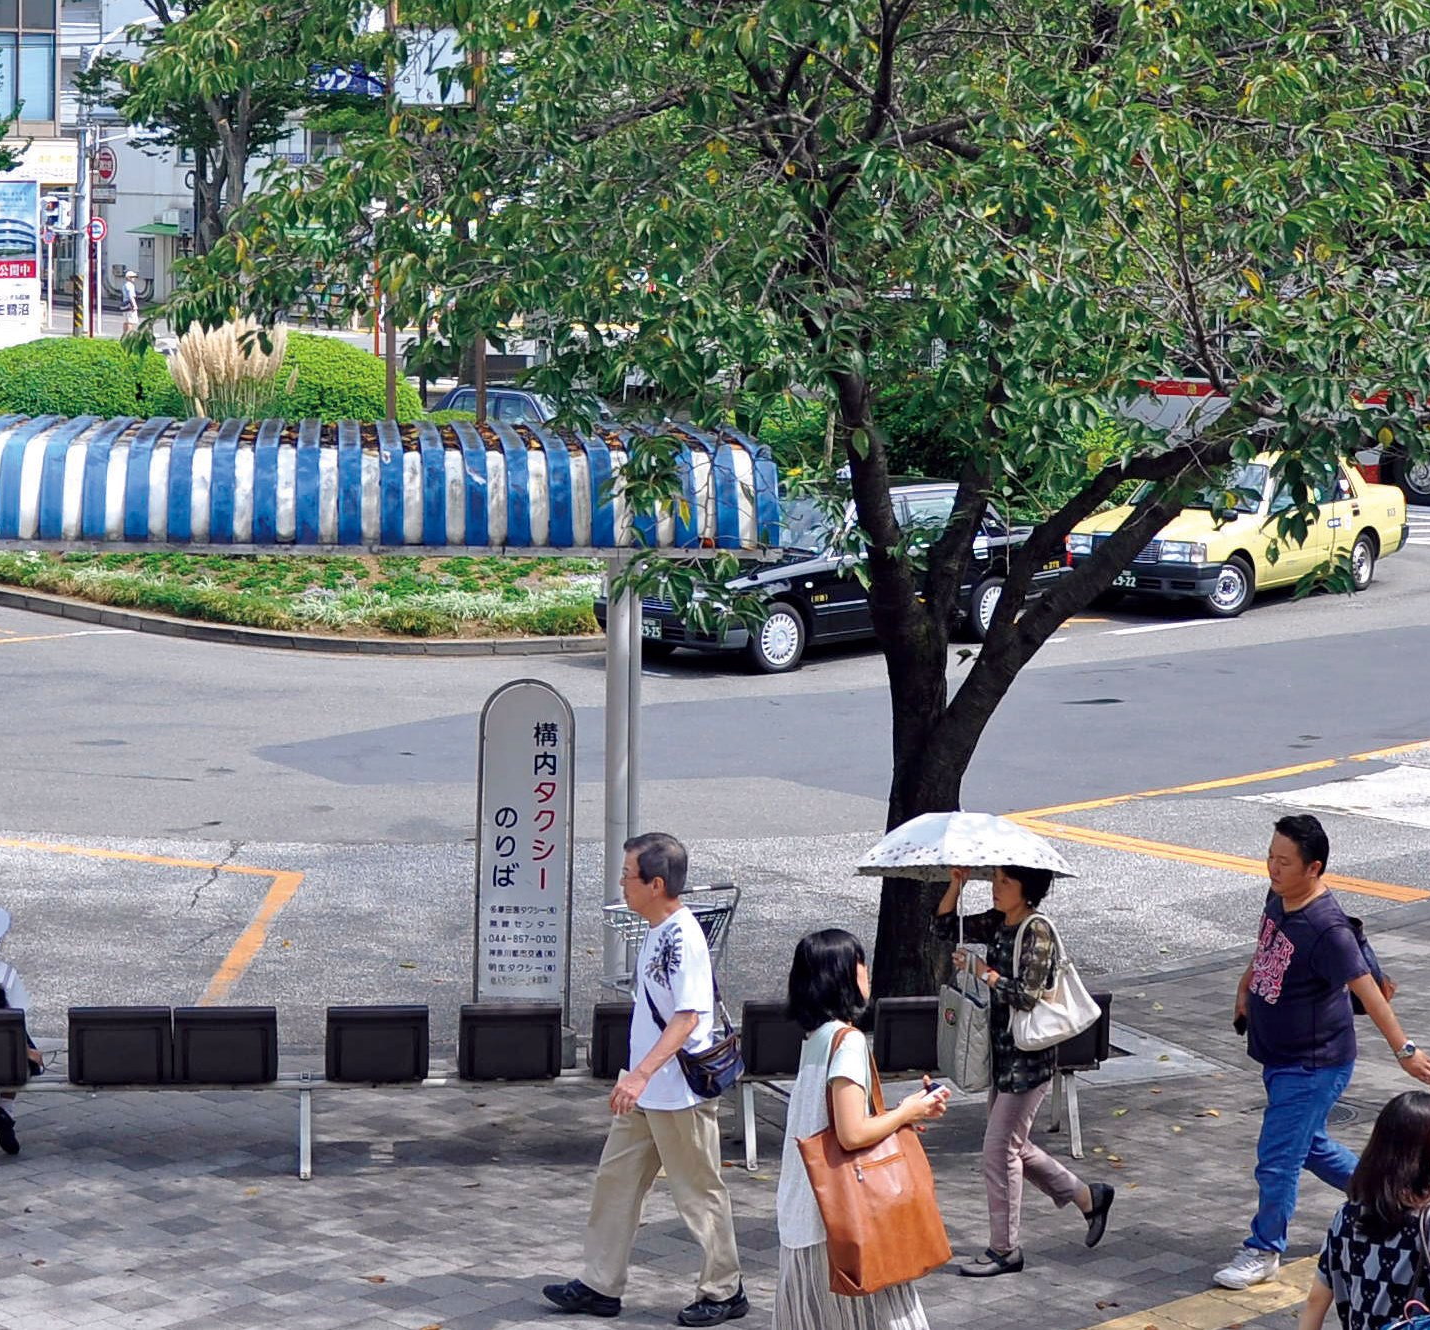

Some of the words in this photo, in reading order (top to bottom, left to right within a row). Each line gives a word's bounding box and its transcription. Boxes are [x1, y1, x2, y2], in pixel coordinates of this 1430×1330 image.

[492, 806, 520, 888] のりば
[533, 722, 558, 890] 構内タクシー
[488, 934, 557, 943] 044-857-0100
